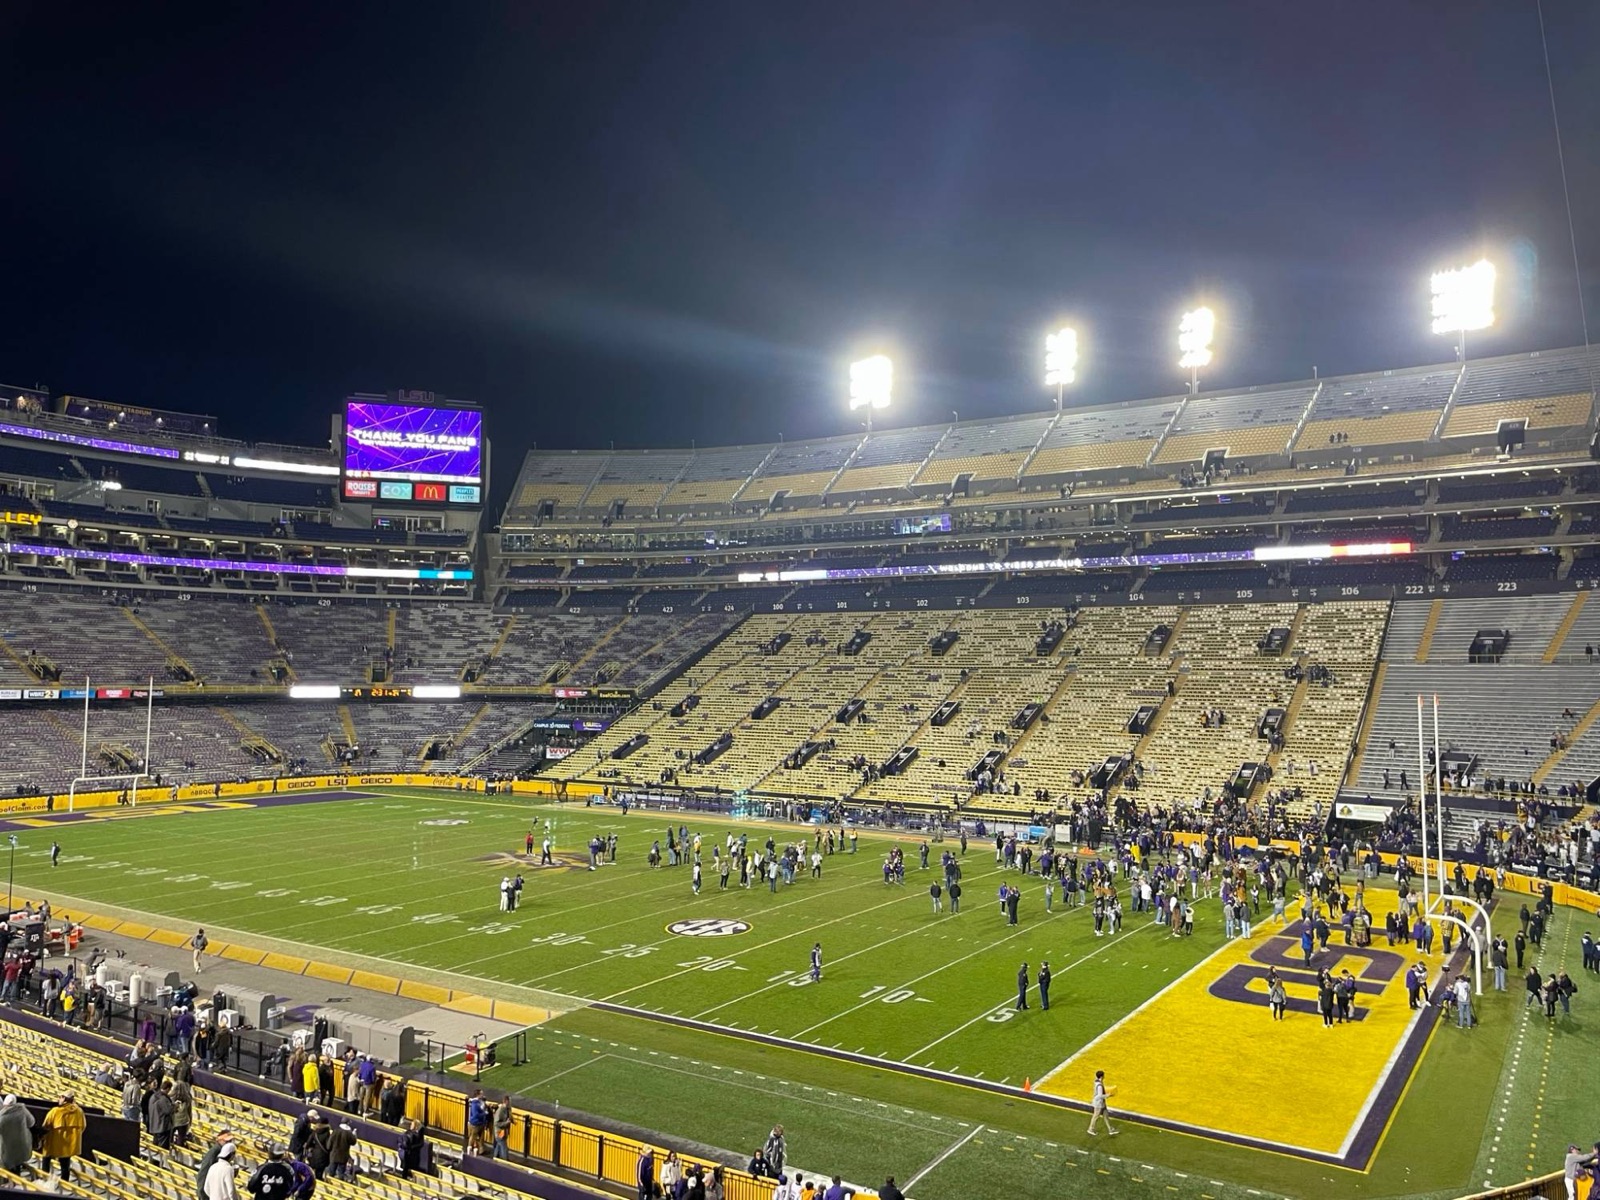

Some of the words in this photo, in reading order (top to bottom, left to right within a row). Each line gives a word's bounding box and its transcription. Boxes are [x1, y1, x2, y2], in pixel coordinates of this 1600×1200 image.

[353, 429, 402, 441] THANK
[405, 433, 436, 444] YOU
[437, 435, 477, 447] FANS
[347, 482, 376, 491] ROUSES
[381, 486, 410, 496] COX
[0, 511, 42, 525] LEY
[1341, 587, 1359, 595] 106
[1405, 585, 1424, 594] 222
[1497, 582, 1517, 591] 223
[178, 593, 191, 601] 419
[1129, 593, 1144, 601] 104
[1236, 590, 1253, 598] 105
[916, 599, 928, 607] 102
[287, 780, 316, 789] GEICO
[327, 778, 349, 787] LSU
[360, 777, 392, 785] GEICO
[532, 932, 586, 946] 30
[601, 943, 659, 958] 25
[676, 956, 737, 972] 20
[767, 970, 824, 987] 15
[859, 985, 916, 1003] 10
[986, 1007, 1019, 1023] 5
